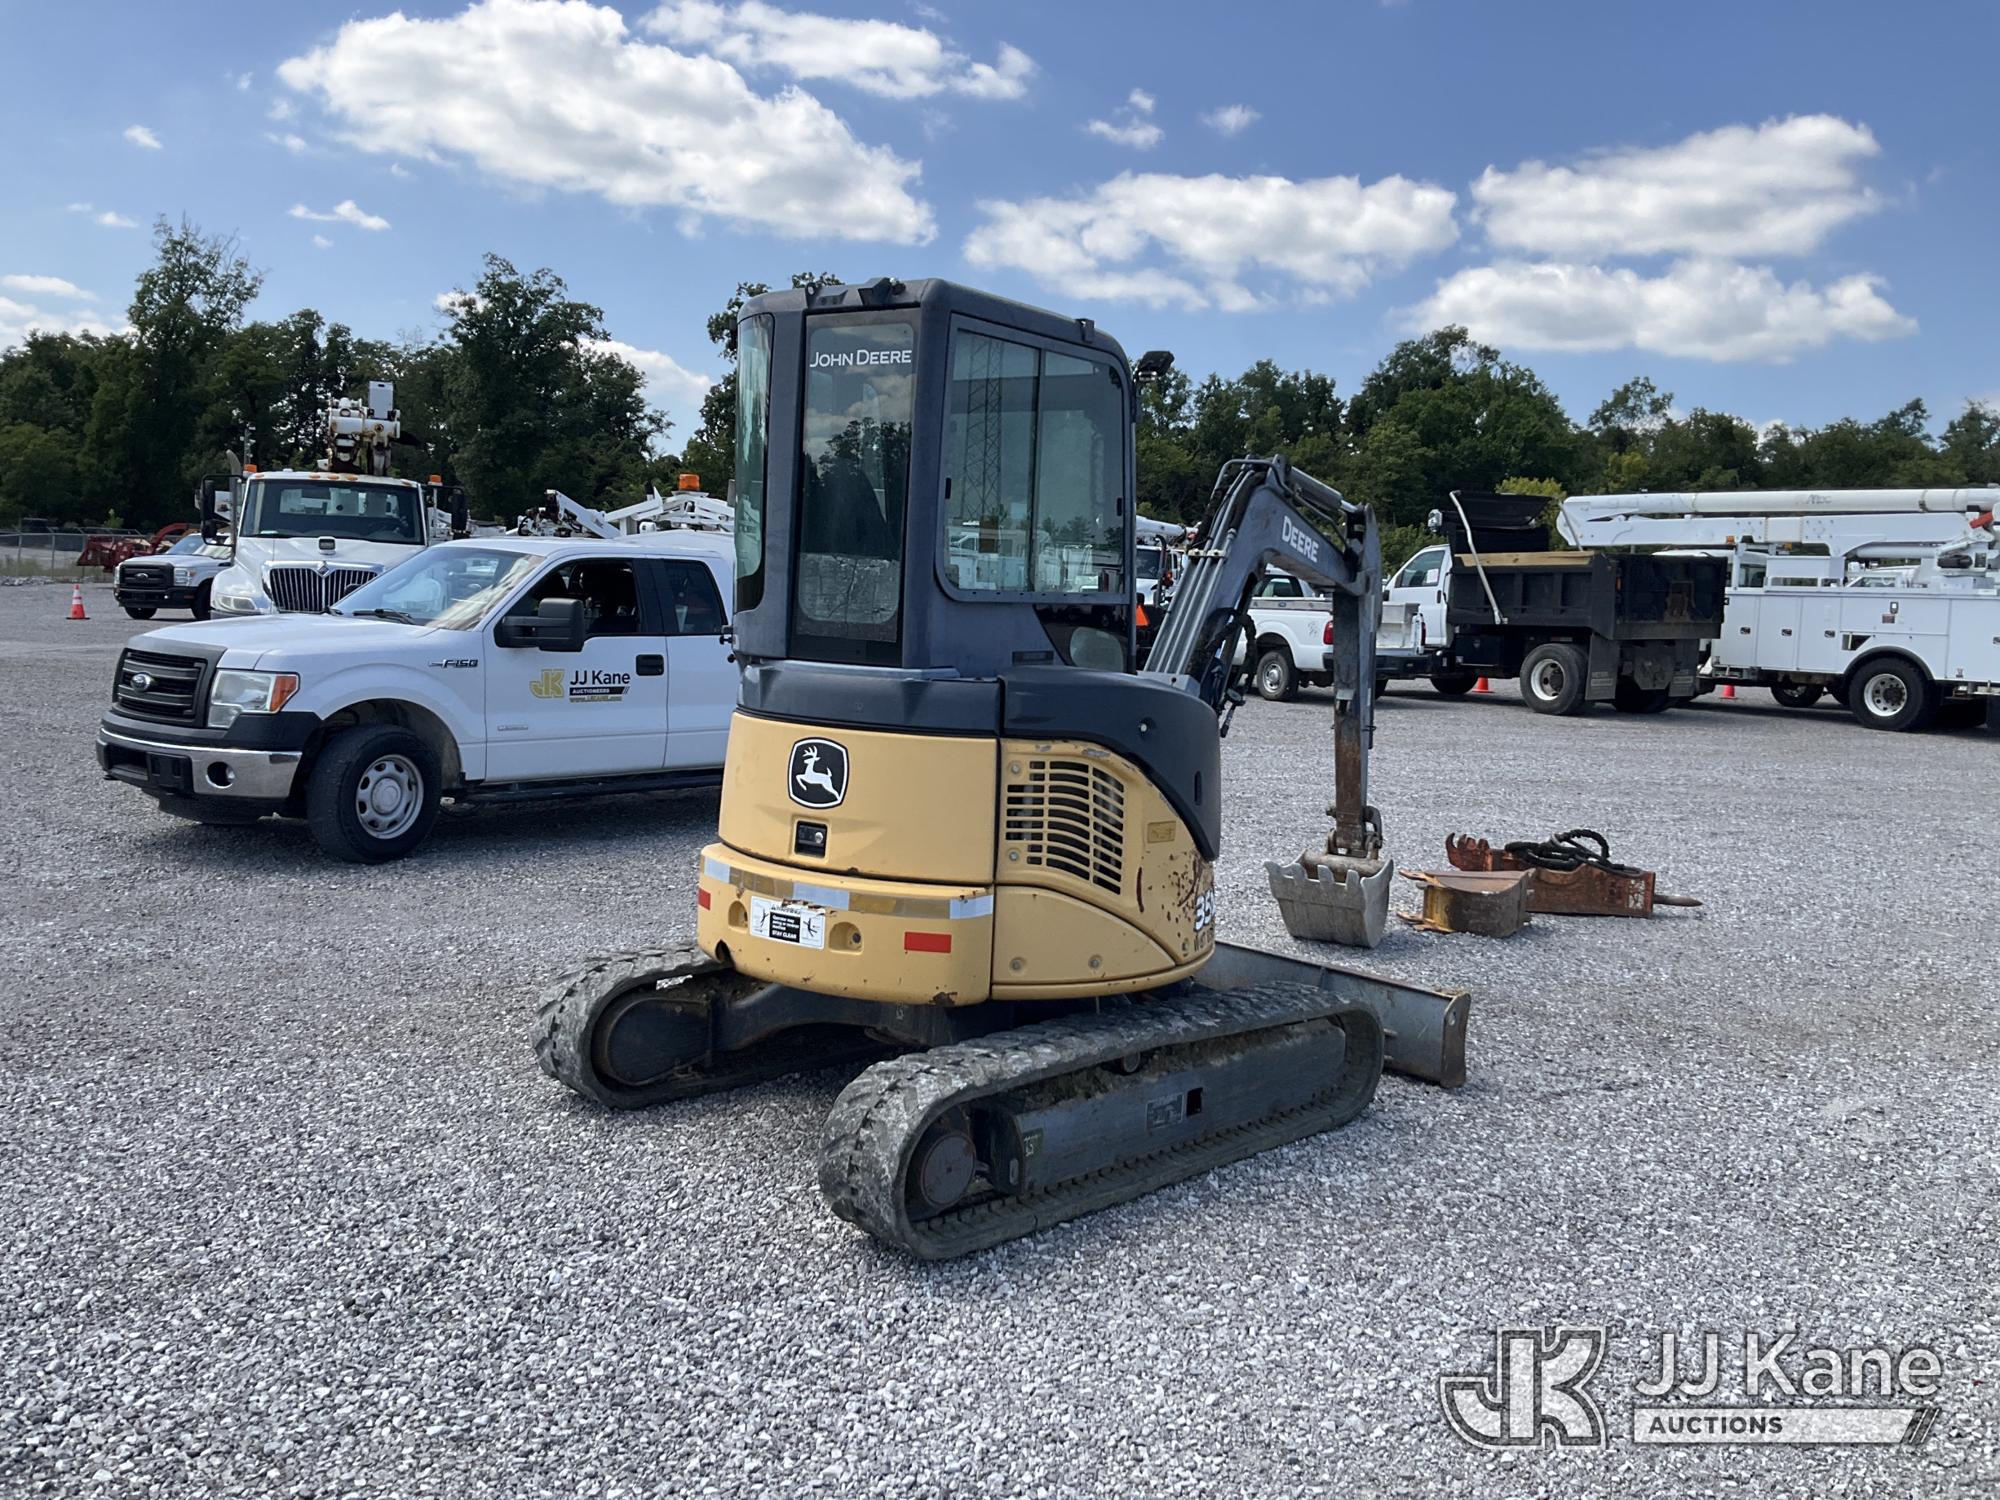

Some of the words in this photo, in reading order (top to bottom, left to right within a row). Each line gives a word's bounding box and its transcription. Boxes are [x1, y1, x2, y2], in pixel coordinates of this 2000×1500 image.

[809, 351, 854, 368] JOHN
[856, 349, 912, 365] DEERE
[1282, 515, 1319, 563] DEERE
[570, 670, 588, 685] JJ
[592, 670, 631, 685] Kane
